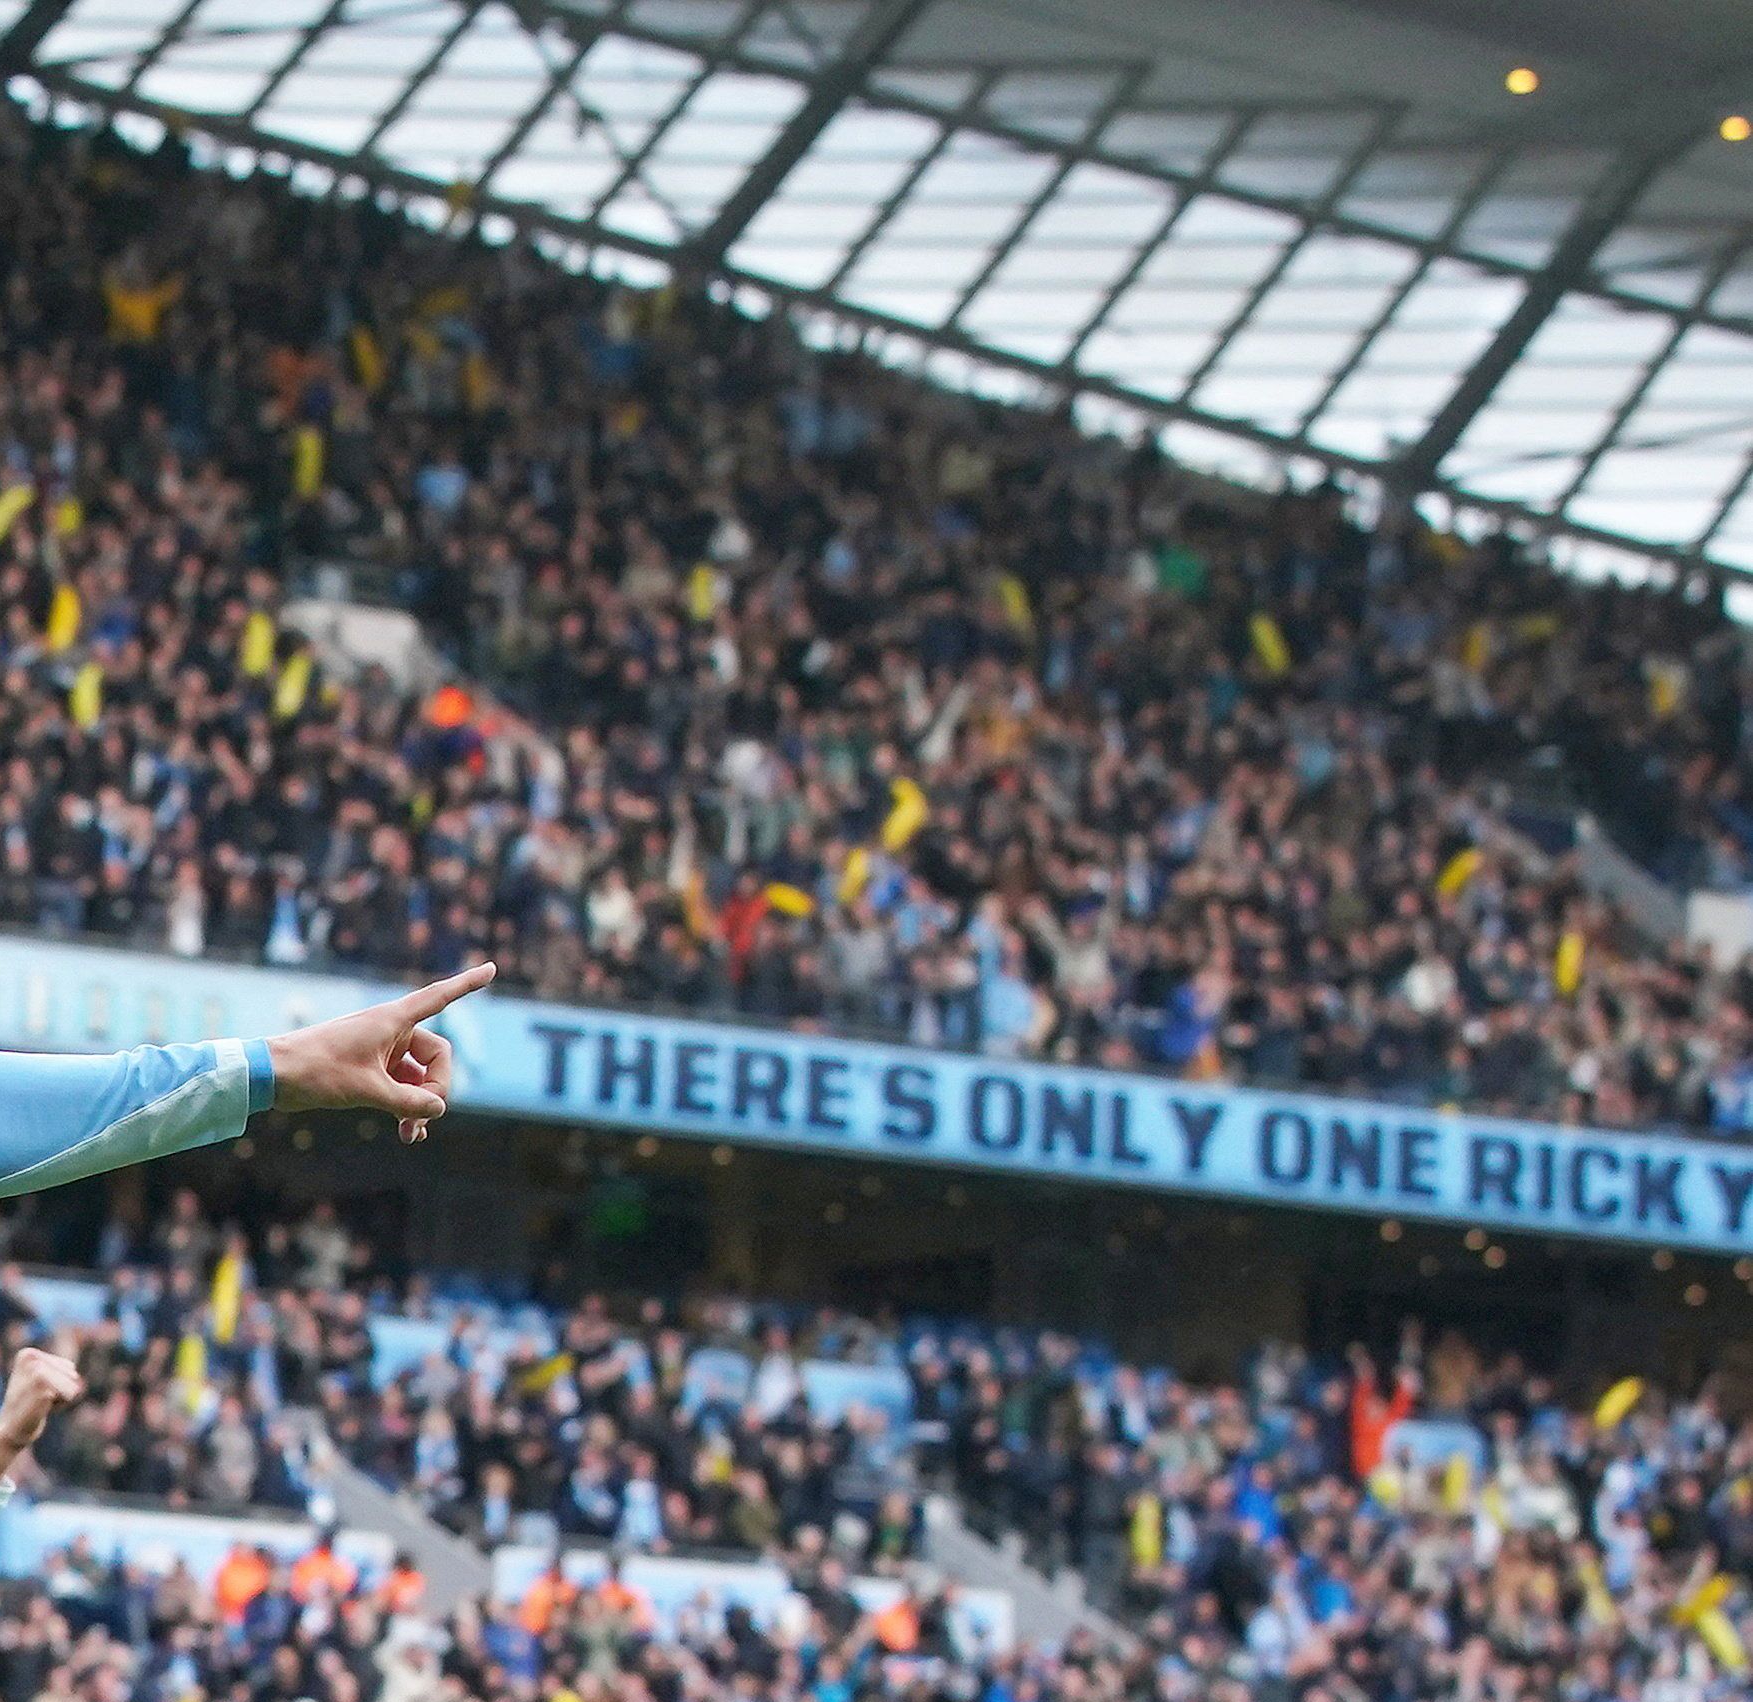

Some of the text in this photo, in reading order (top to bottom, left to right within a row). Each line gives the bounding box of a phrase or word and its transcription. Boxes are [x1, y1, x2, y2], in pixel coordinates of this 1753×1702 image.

[968, 1074, 1224, 1172] ONLY
[1258, 1110, 1439, 1197] ONE
[1468, 1136, 1753, 1235] RICKY
